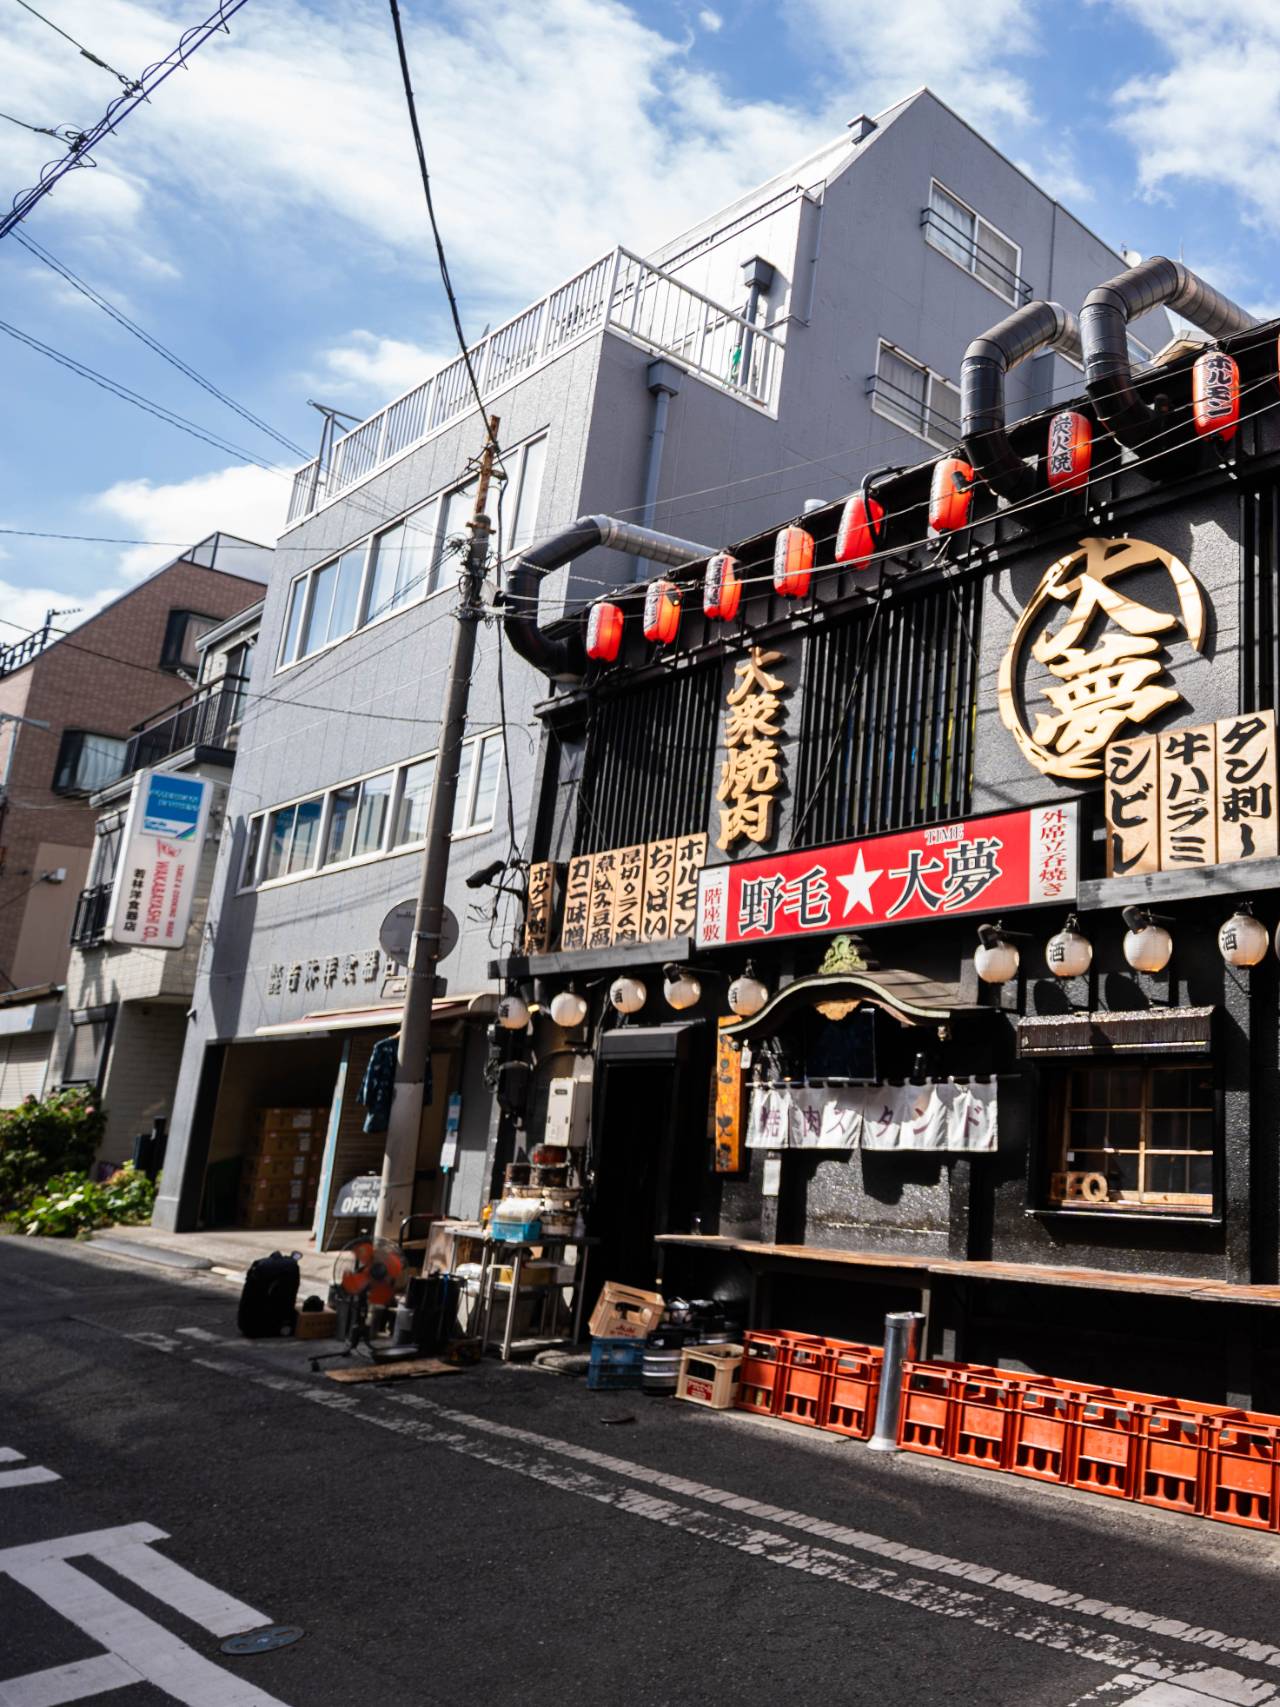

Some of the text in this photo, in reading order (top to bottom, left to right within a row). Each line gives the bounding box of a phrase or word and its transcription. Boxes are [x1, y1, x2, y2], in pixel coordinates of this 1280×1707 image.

[1204, 354, 1233, 419] ホルモン
[1050, 414, 1074, 475] 炭火焼
[1031, 537, 1180, 755] 大夢
[716, 645, 786, 851] 大衆焼肉
[923, 823, 966, 847] TIME
[1109, 745, 1155, 875] シビレ
[1164, 731, 1212, 863] 牛ハラミ
[674, 839, 704, 935] ホルモン
[738, 836, 1004, 936] 野毛 大夢
[1049, 941, 1066, 963] 酒
[1220, 927, 1239, 951] 酒
